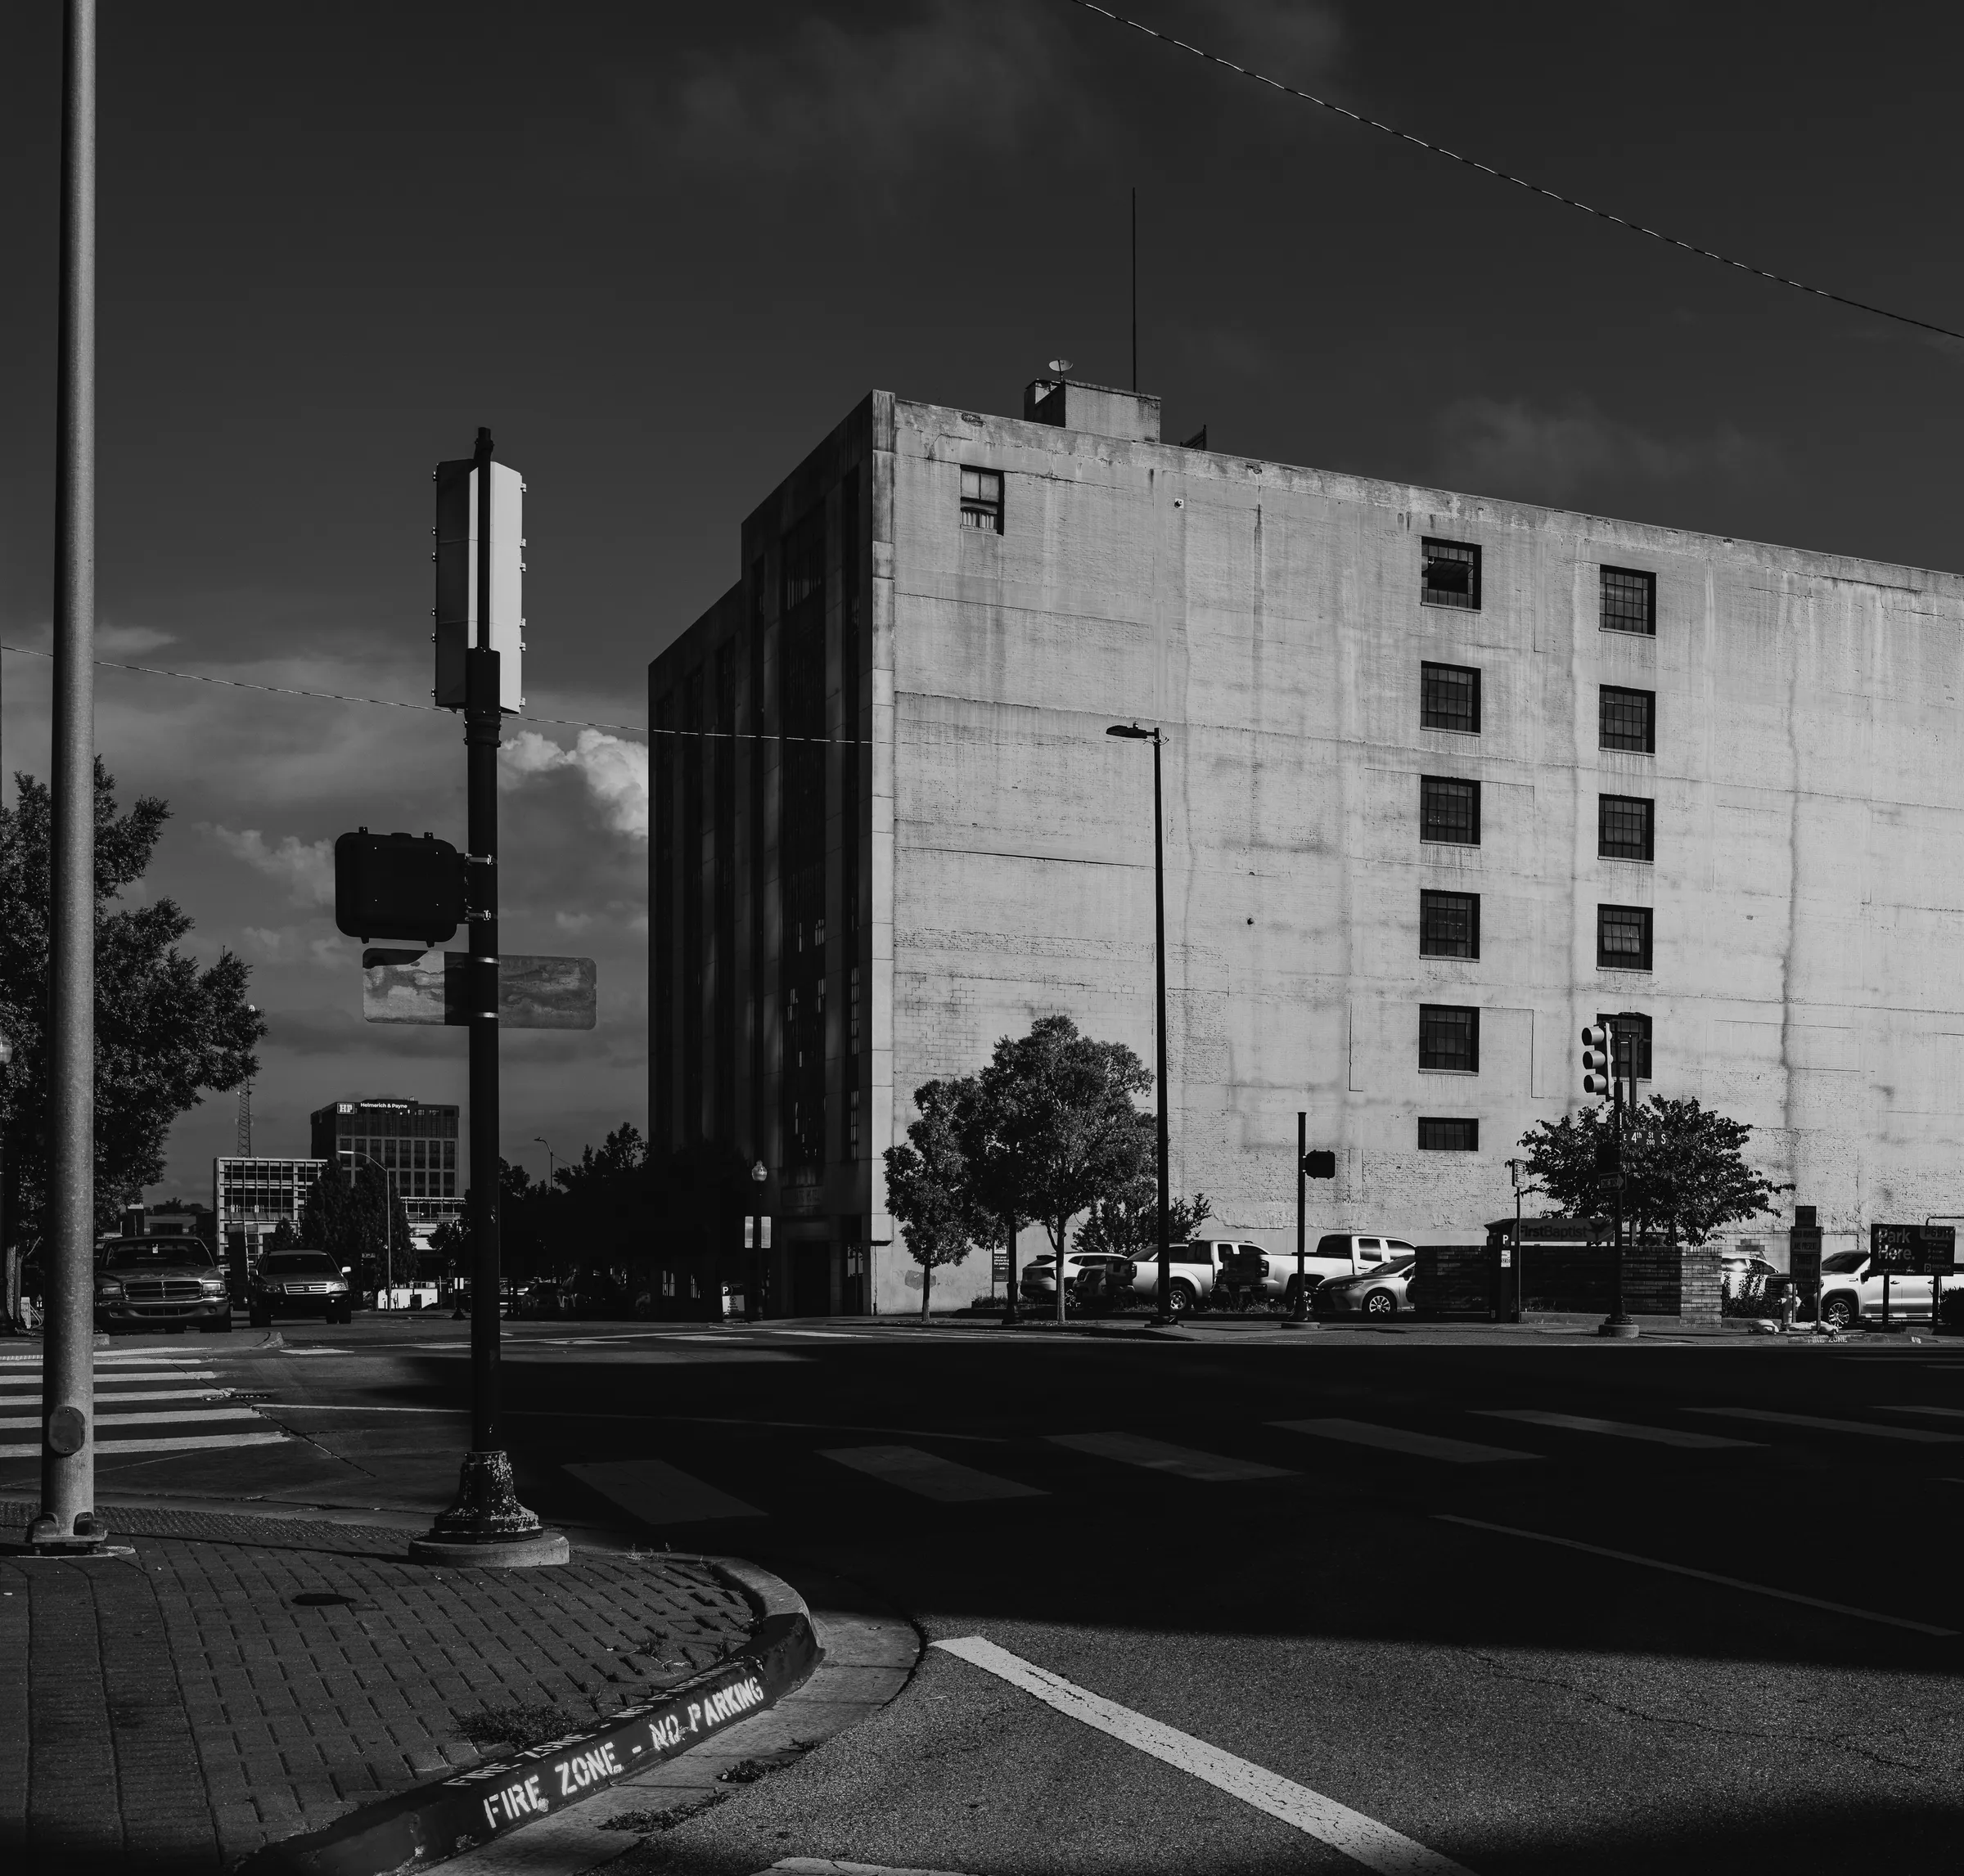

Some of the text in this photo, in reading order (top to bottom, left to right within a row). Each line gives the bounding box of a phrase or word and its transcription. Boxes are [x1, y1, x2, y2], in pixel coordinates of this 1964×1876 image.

[339, 1104, 353, 1113] HP
[1631, 1131, 1642, 1144] 4th
[1660, 1133, 1666, 1145] S
[1502, 1234, 1509, 1244] P
[1520, 1225, 1588, 1240] FirstBaptist
[1878, 1227, 1911, 1244] Park
[1878, 1244, 1916, 1260] Here.
[723, 1286, 729, 1295] P
[483, 1676, 764, 1829] FIRE ZONE - NO PARKING
